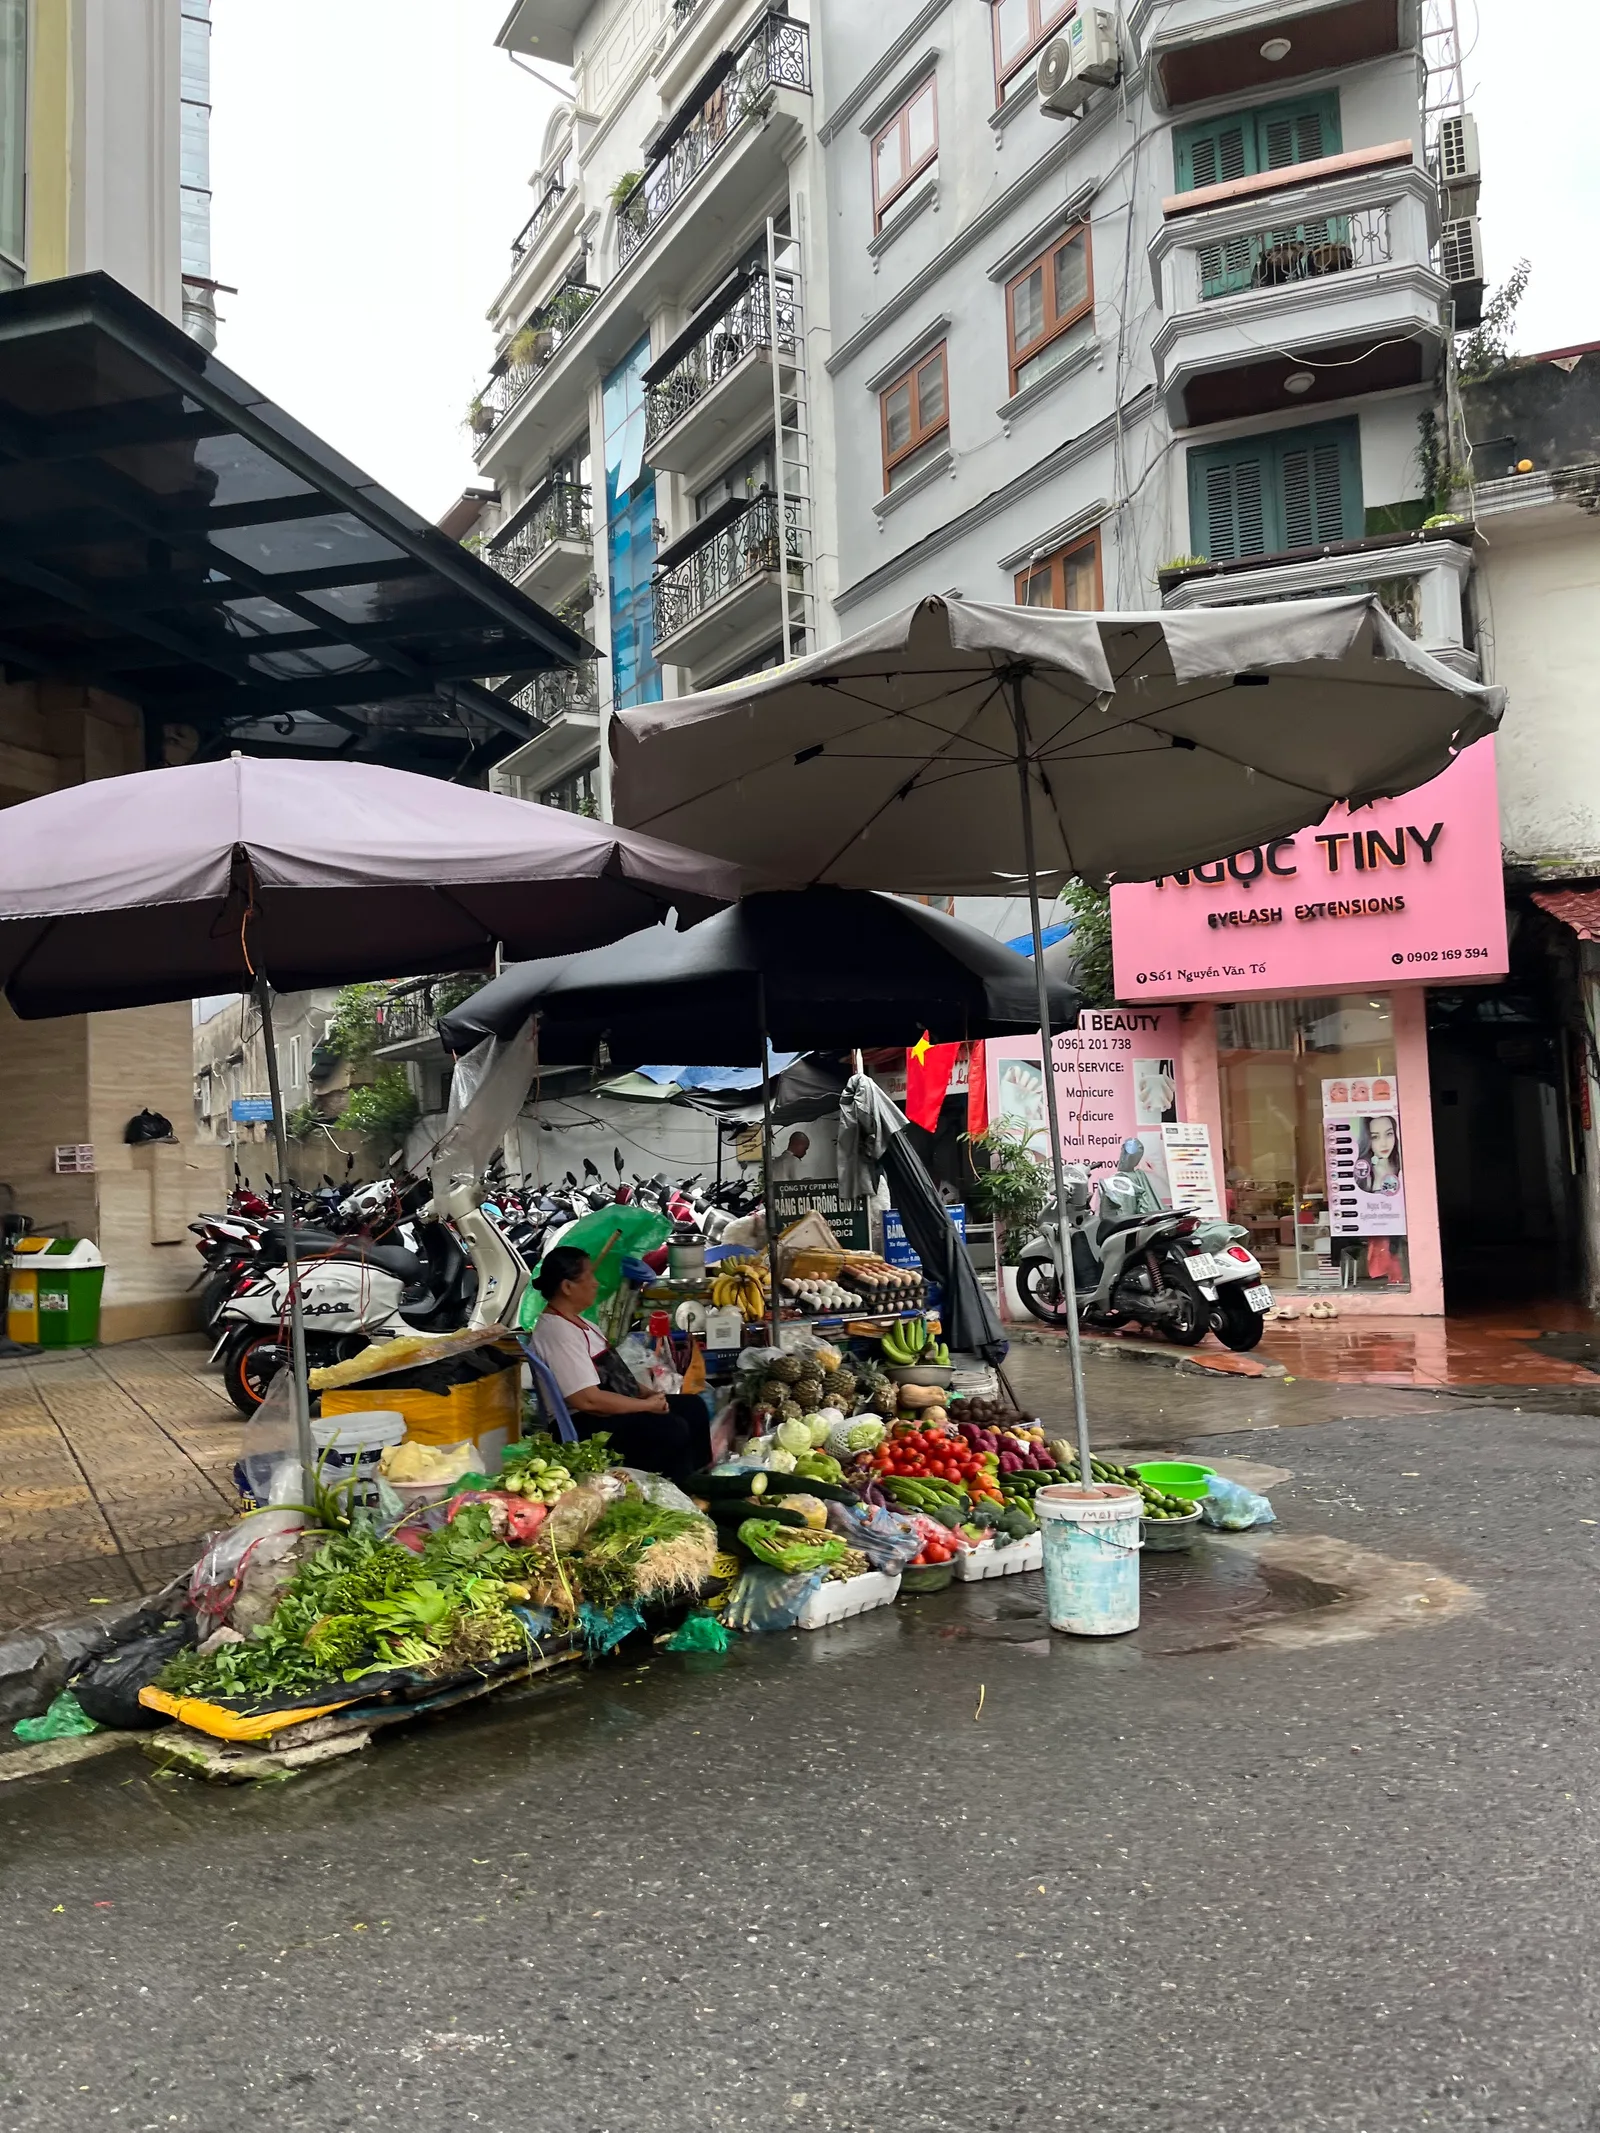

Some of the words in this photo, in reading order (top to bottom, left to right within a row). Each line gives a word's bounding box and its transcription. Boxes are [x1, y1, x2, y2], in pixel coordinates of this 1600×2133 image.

[1315, 822, 1444, 872] TINY
[1208, 906, 1283, 928] EYELASH
[1295, 896, 1406, 920] EXTENSIONS
[1407, 951, 1439, 963] 0902
[1441, 950, 1462, 962] 169
[1465, 948, 1489, 960] 394
[1222, 966, 1245, 976] Văn
[1250, 962, 1267, 974] Tố
[1092, 1015, 1161, 1031] BEAUTY
[1058, 1039, 1084, 1050] 0961
[1088, 1038, 1108, 1049] 201
[1112, 1038, 1131, 1049] 738
[1052, 1063, 1075, 1072] OUR
[1078, 1063, 1124, 1072] SERVICE:
[1066, 1087, 1114, 1098] Manicure
[1069, 1111, 1114, 1121] Pedicure
[1063, 1135, 1085, 1146] Nail
[1088, 1134, 1122, 1149] Repair
[780, 1184, 798, 1192] CÔNG
[809, 1183, 827, 1191] CPTM
[798, 1193, 811, 1215] GIÁ
[812, 1192, 838, 1213] TRÔNG
